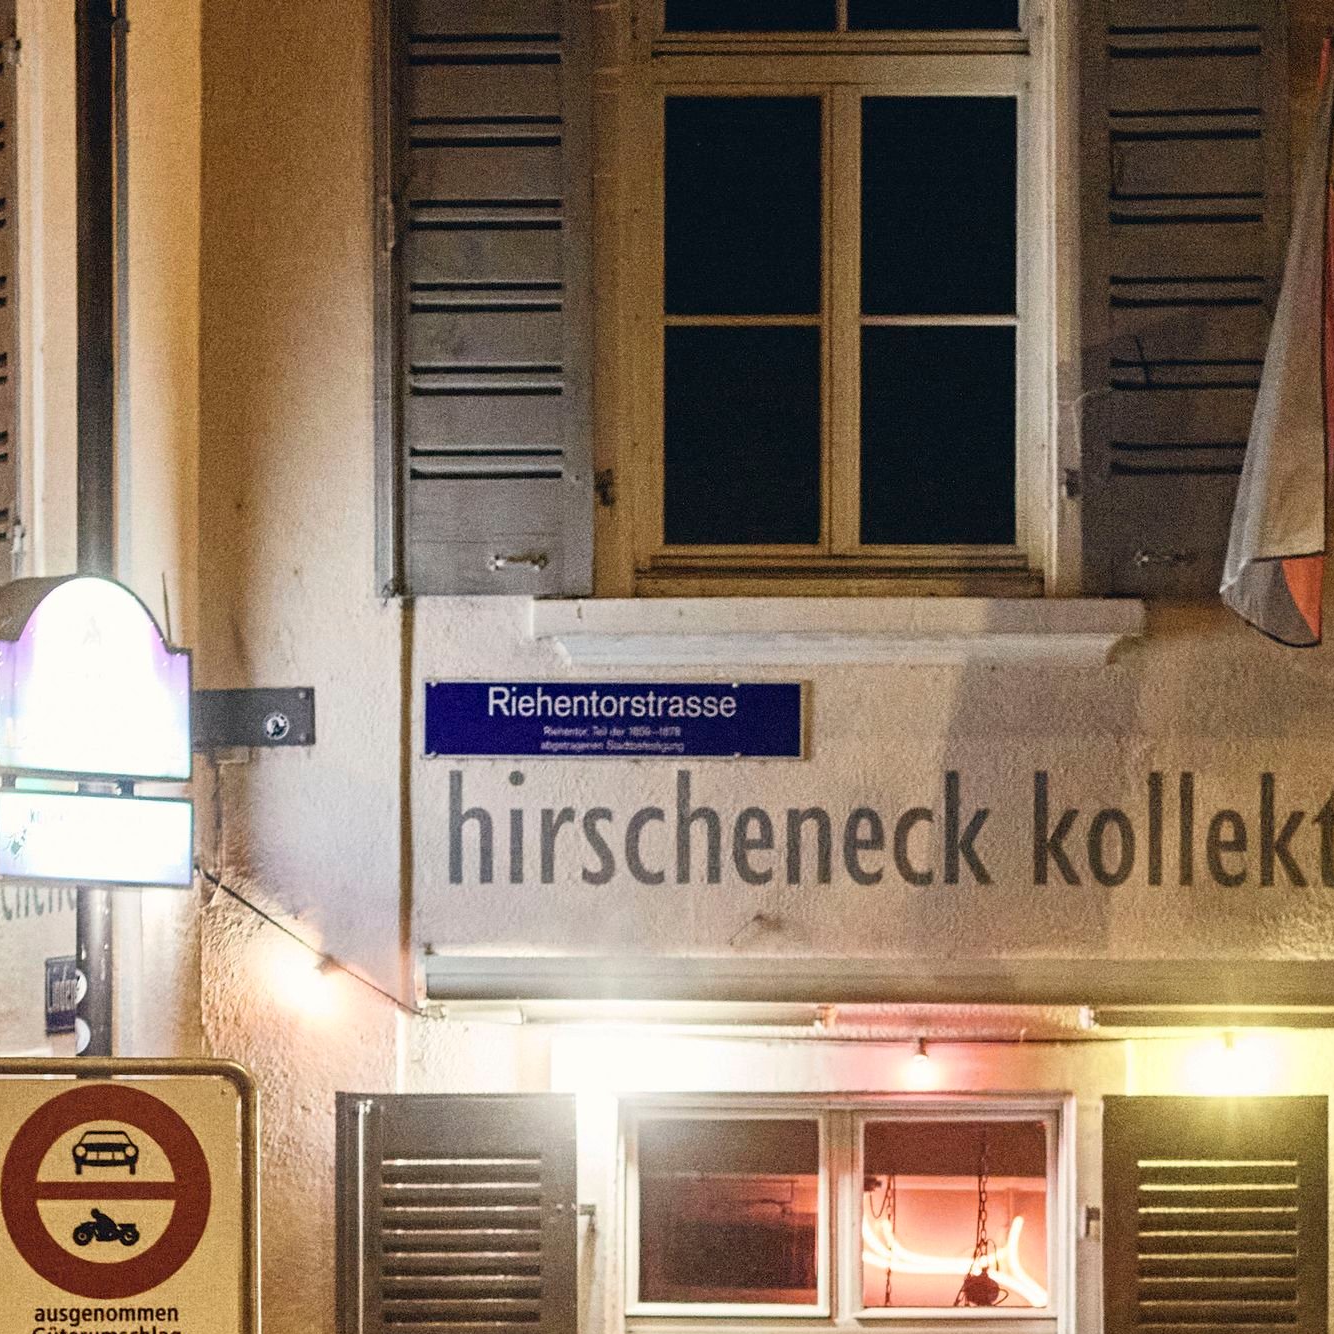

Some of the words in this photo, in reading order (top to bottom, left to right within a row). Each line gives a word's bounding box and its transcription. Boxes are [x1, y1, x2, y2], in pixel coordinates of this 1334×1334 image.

[487, 686, 737, 718] Riehentorstrasse
[448, 769, 995, 887] hirscheneck
[34, 1307, 179, 1326] ausgenommen
